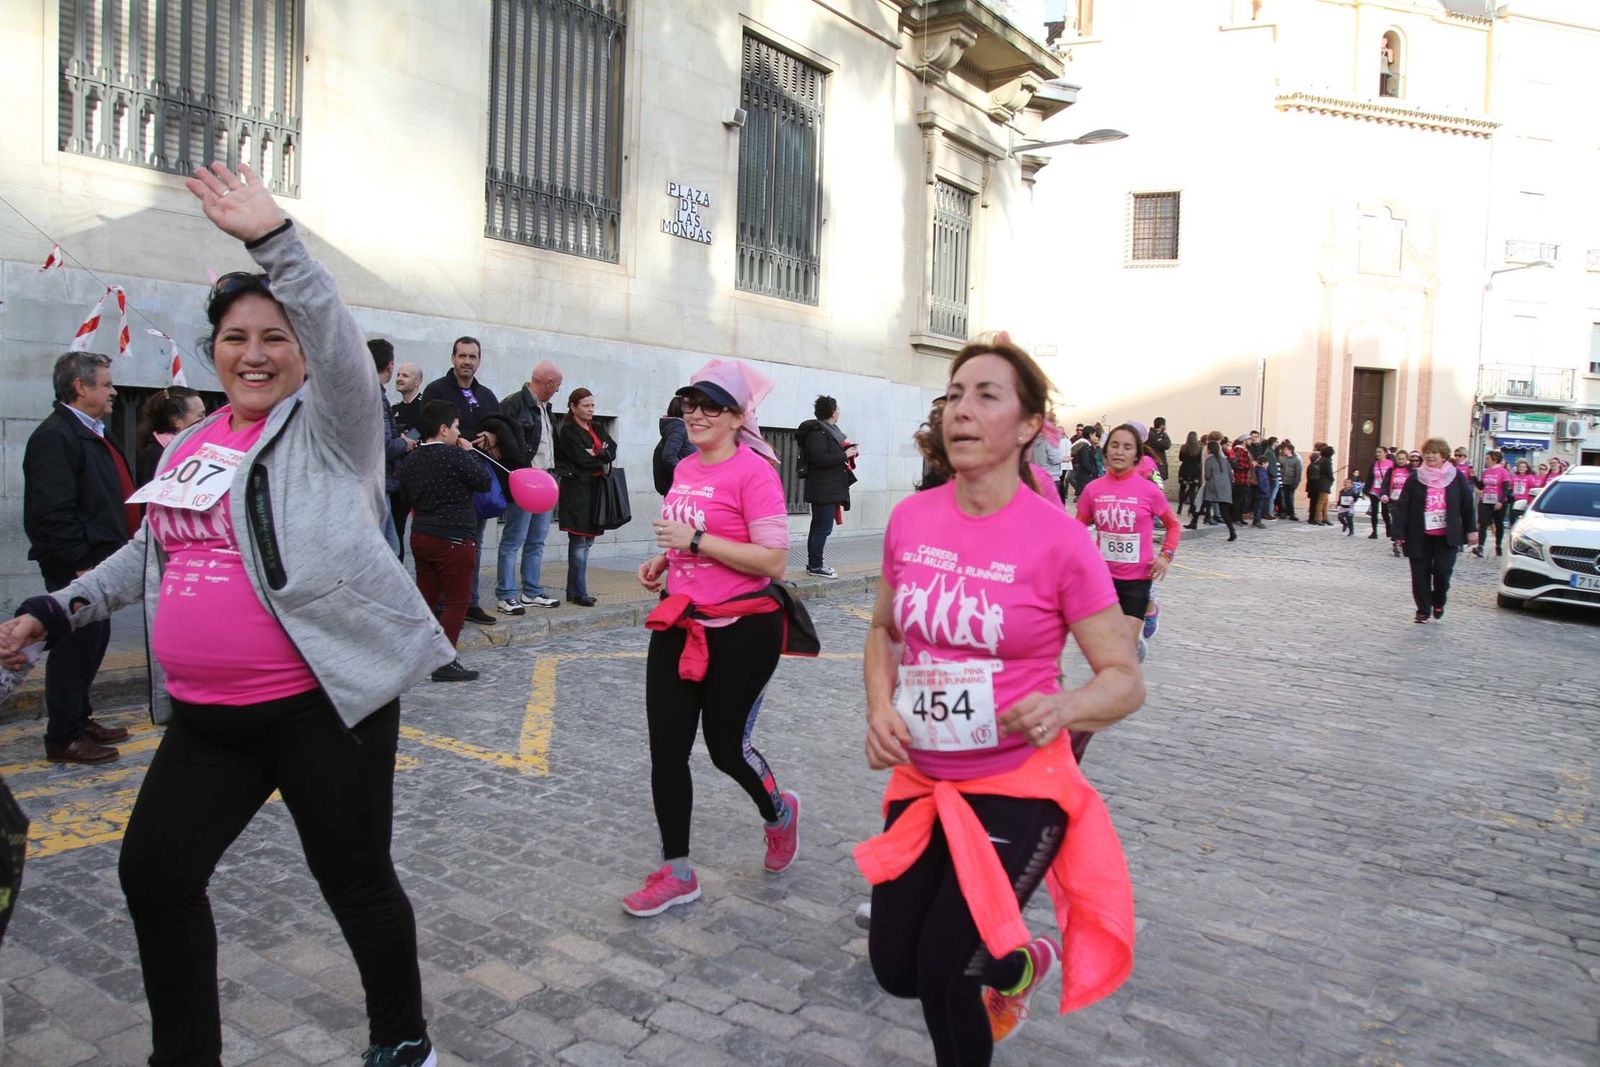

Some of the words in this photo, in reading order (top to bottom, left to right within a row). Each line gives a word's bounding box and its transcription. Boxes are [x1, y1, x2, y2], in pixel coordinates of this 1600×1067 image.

[669, 182, 710, 206] PLAZA
[681, 199, 697, 214] DE
[677, 210, 701, 228] LAS
[662, 219, 712, 244] MONJAS
[918, 544, 958, 562] CARRERA
[1108, 541, 1133, 554] 638
[964, 565, 1014, 584] RUNNING
[990, 561, 1018, 573] PINK
[912, 689, 975, 722] 454
